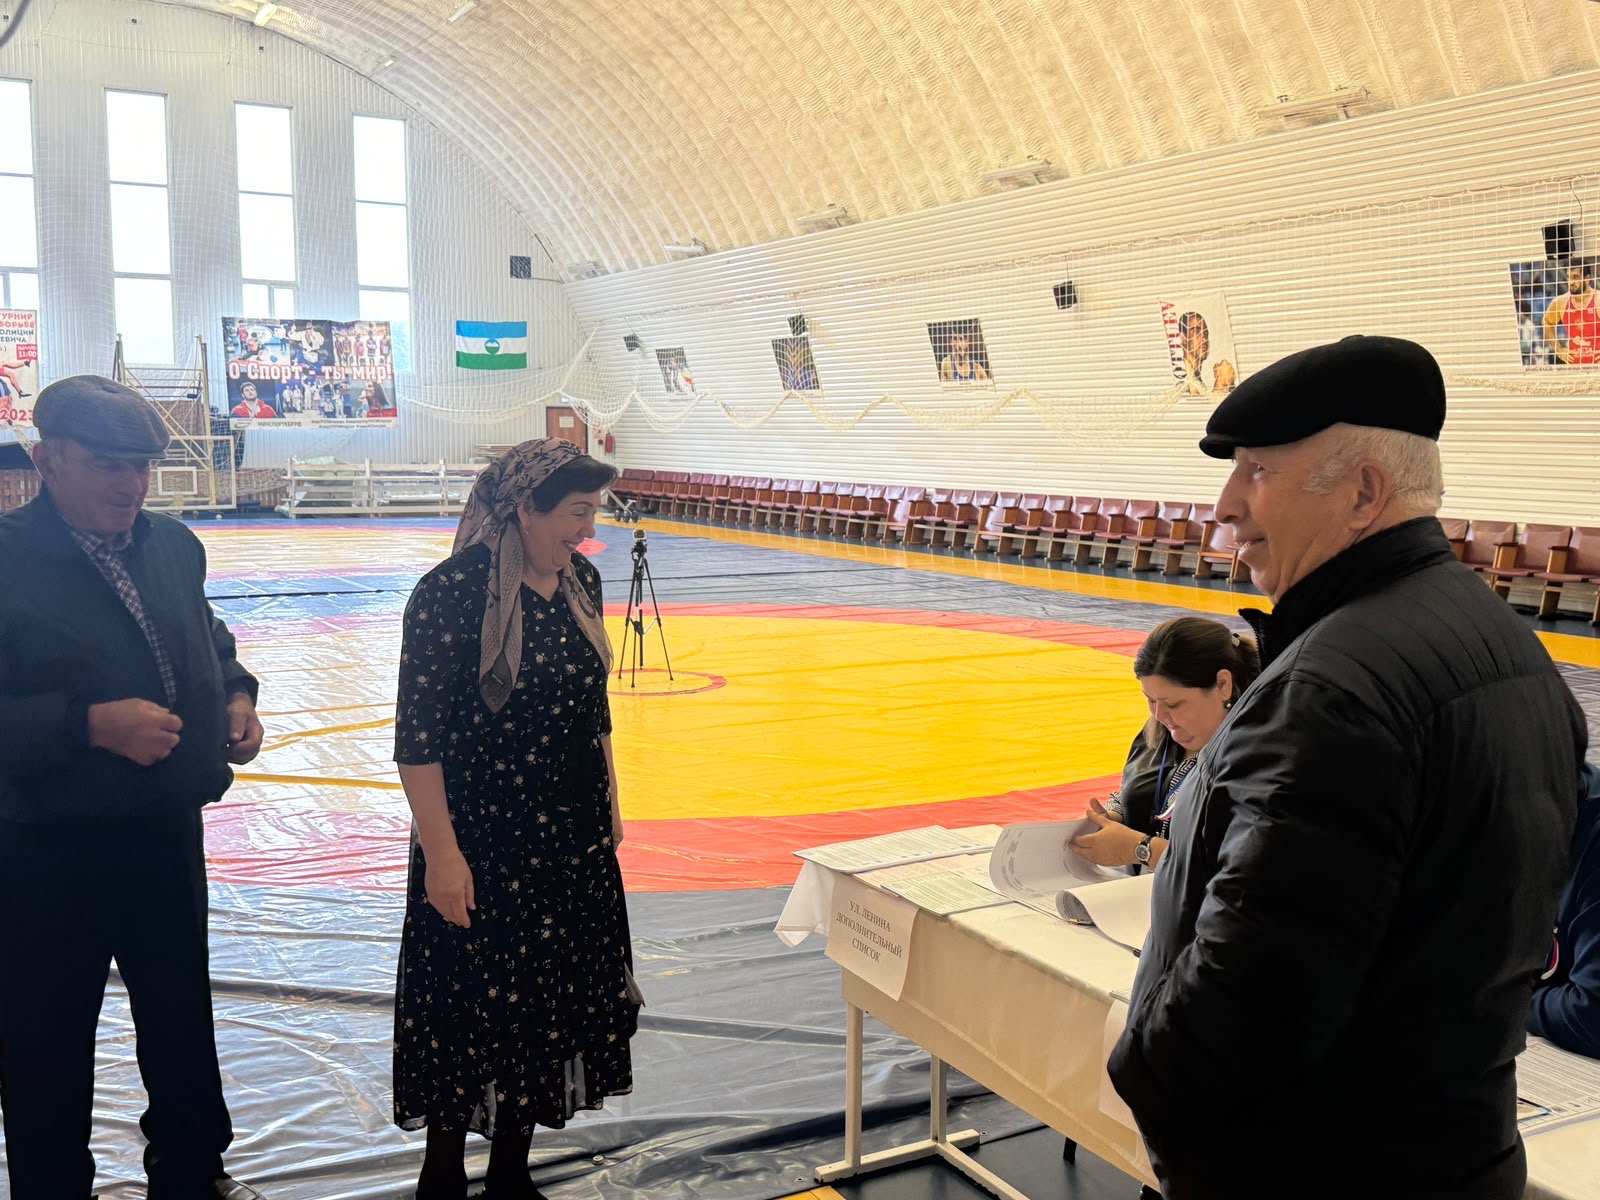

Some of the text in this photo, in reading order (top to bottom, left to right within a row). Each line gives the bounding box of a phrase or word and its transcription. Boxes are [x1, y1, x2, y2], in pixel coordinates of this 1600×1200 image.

[229, 362, 240, 380] О
[247, 362, 301, 384] Спорт
[322, 366, 346, 380] ты
[352, 364, 393, 384] мир!
[850, 901, 891, 932] УЛ. ЛЕНИНА
[836, 912, 902, 958] ДОПОЛНИТЕЛЬНЫЙ
[852, 938, 880, 962] СПИСОК
